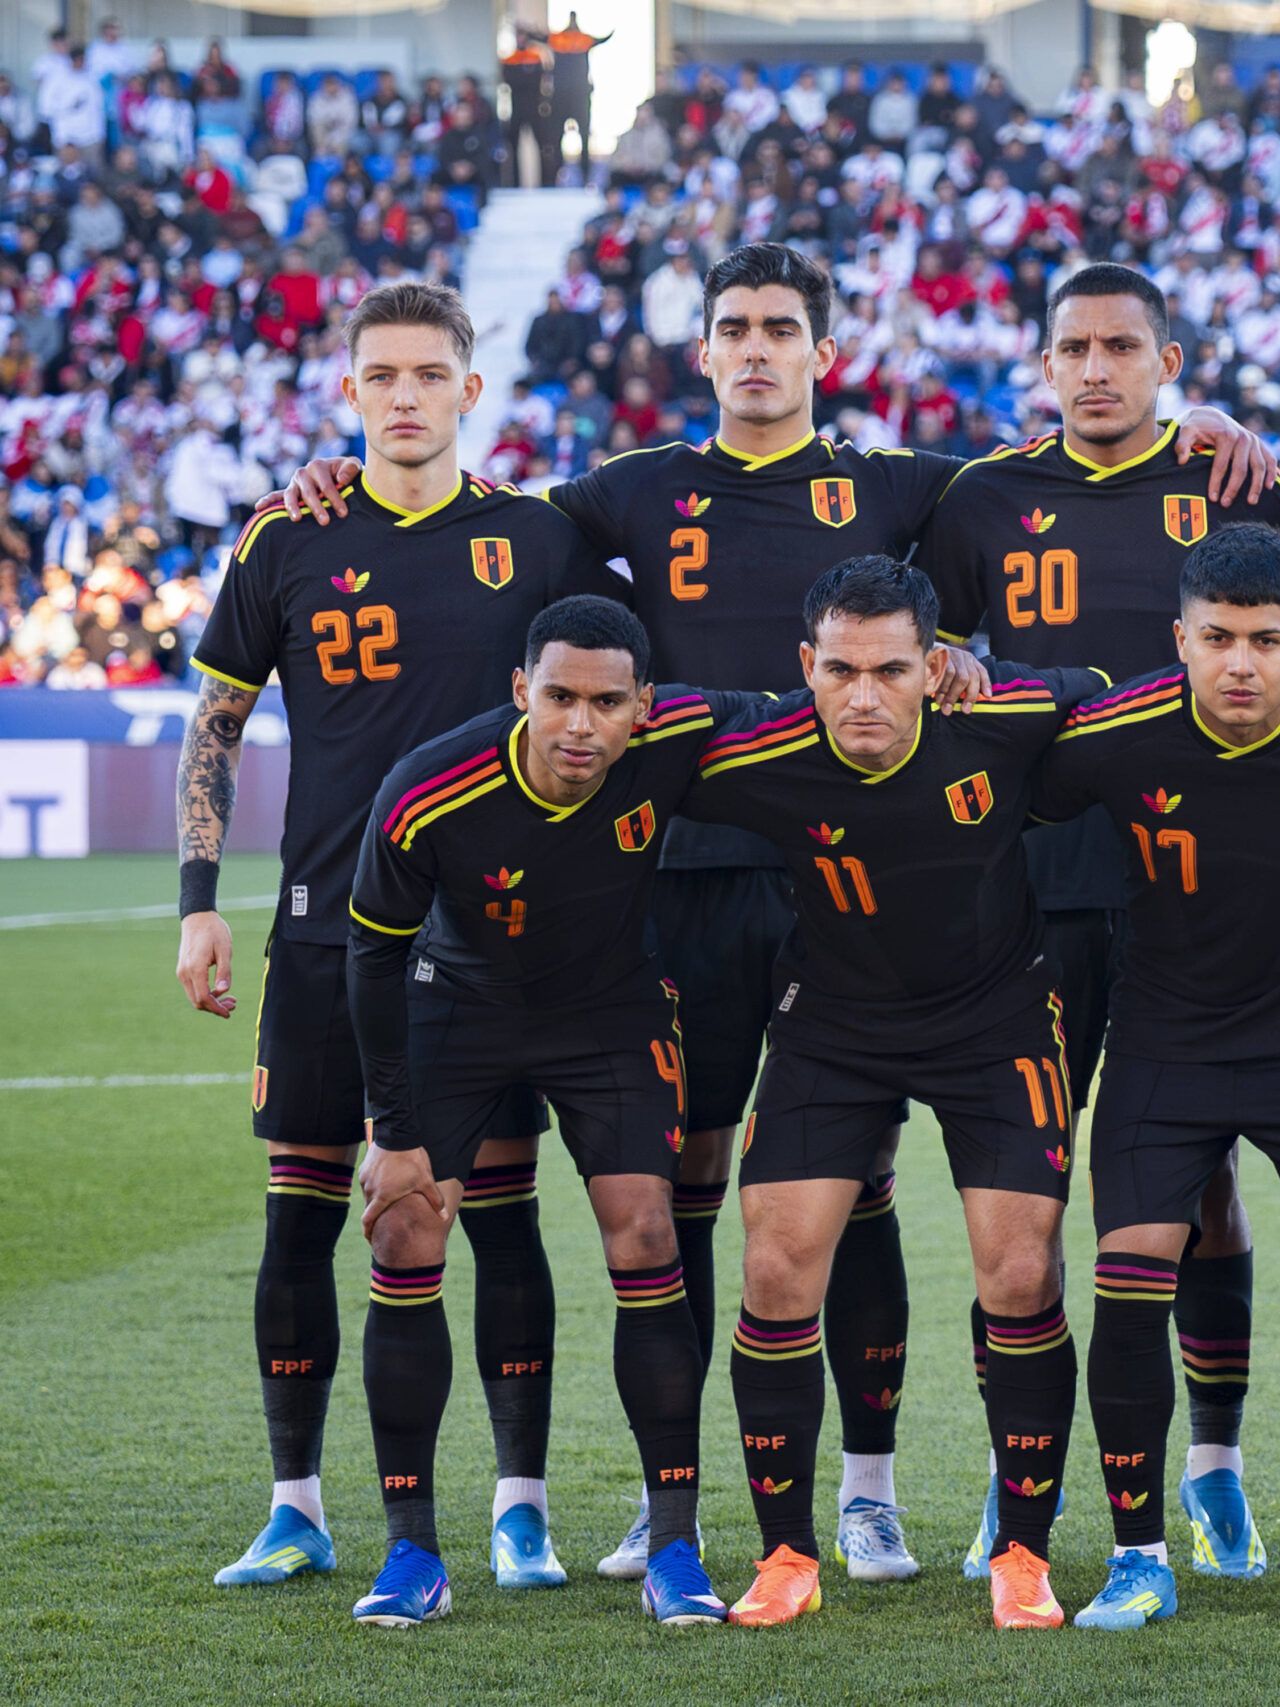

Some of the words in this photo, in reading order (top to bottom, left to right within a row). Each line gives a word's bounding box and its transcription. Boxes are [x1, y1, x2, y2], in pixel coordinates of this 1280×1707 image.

[669, 527, 708, 600] 2
[1003, 549, 1078, 628] 20
[311, 604, 401, 685] 22
[1131, 822, 1197, 894] 17
[815, 856, 878, 916] 11
[486, 899, 527, 937] 4
[650, 1039, 684, 1115] 4
[1015, 1057, 1066, 1131] 11
[272, 1360, 313, 1374] FPF
[502, 1361, 543, 1375] FPF
[745, 1434, 786, 1450] FPF
[1007, 1435, 1052, 1450] FPF
[1104, 1453, 1145, 1467] FPF
[385, 1476, 418, 1489] FPF
[660, 1467, 695, 1482] FPF
